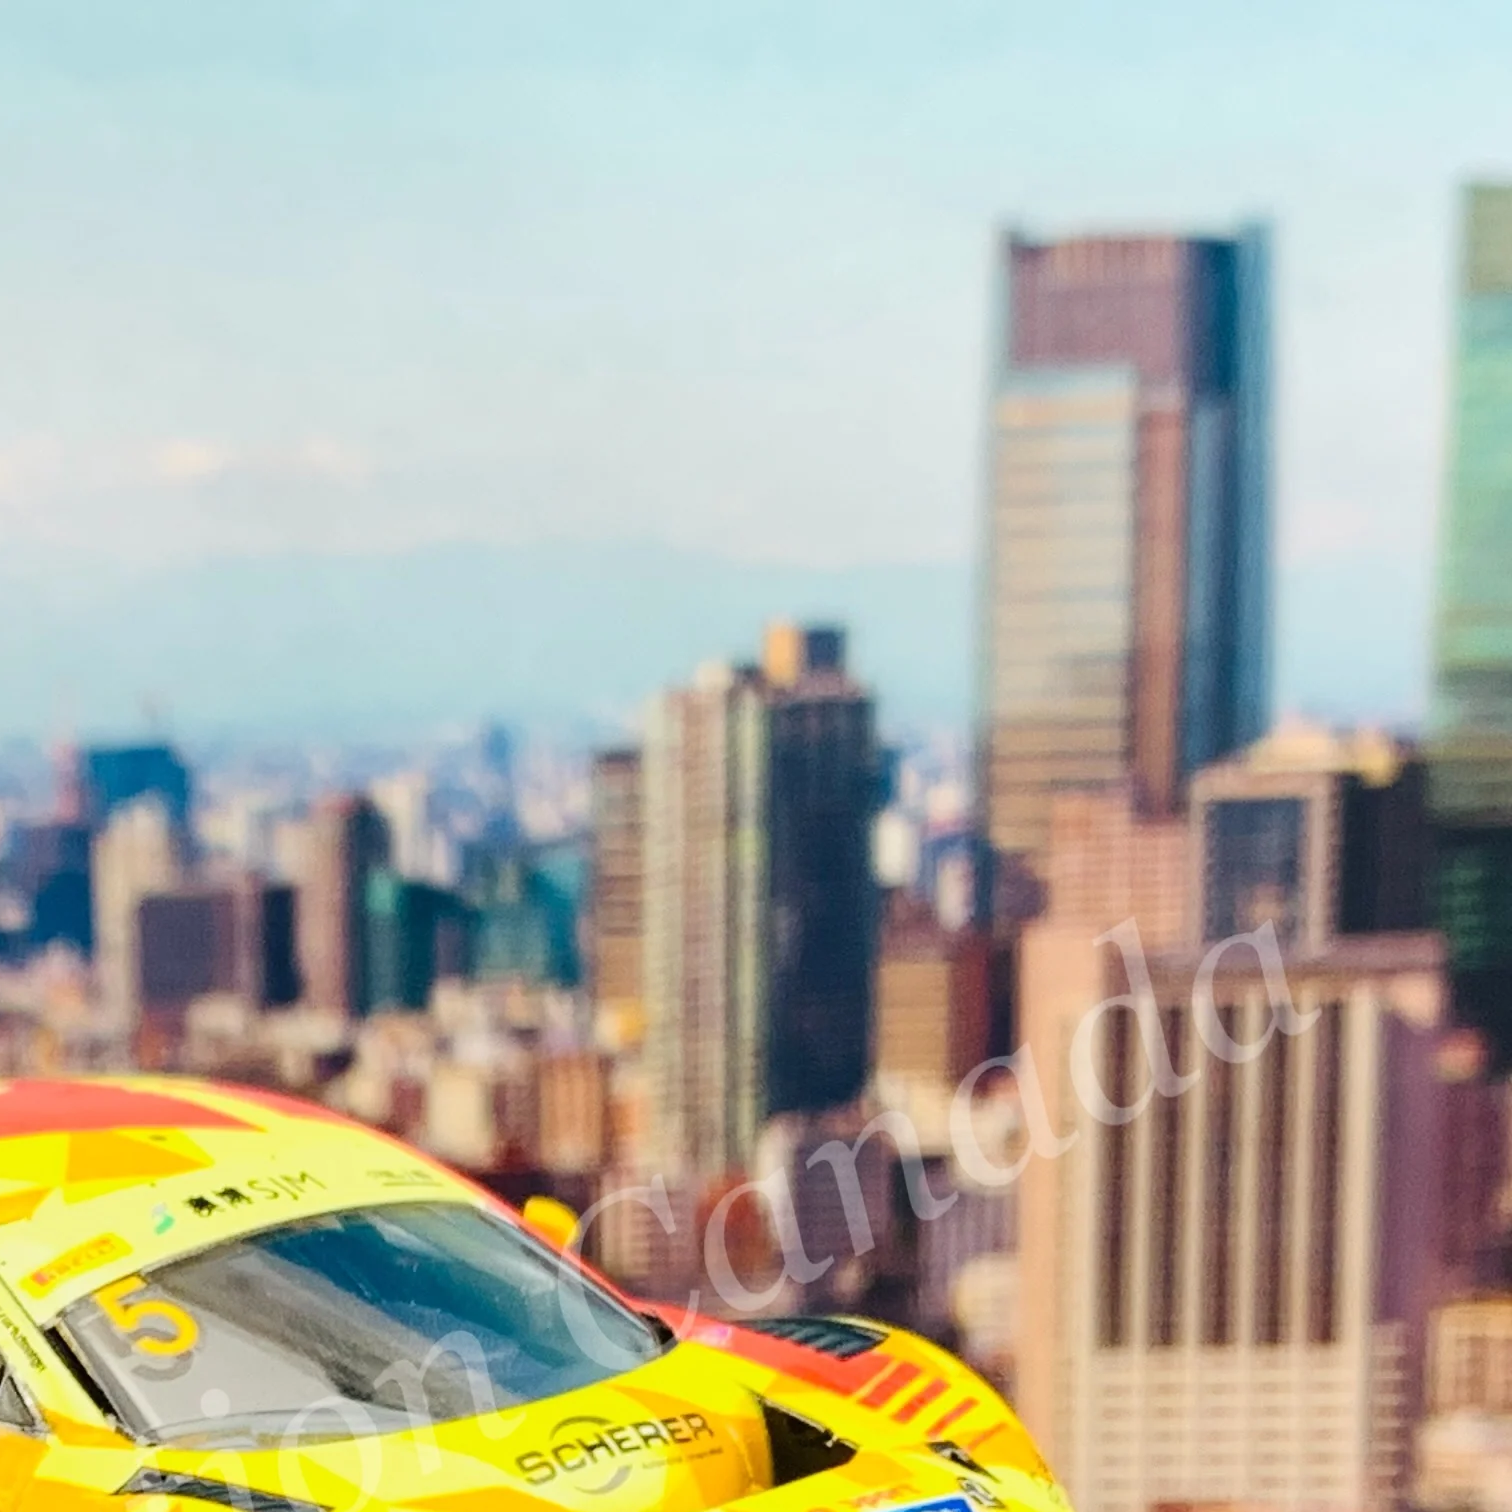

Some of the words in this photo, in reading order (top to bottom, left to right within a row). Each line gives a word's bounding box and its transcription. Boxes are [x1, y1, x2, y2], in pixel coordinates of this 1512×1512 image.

[247, 1169, 328, 1202] SJM
[93, 1275, 200, 1356] 5
[514, 1412, 715, 1486] SCHERER
